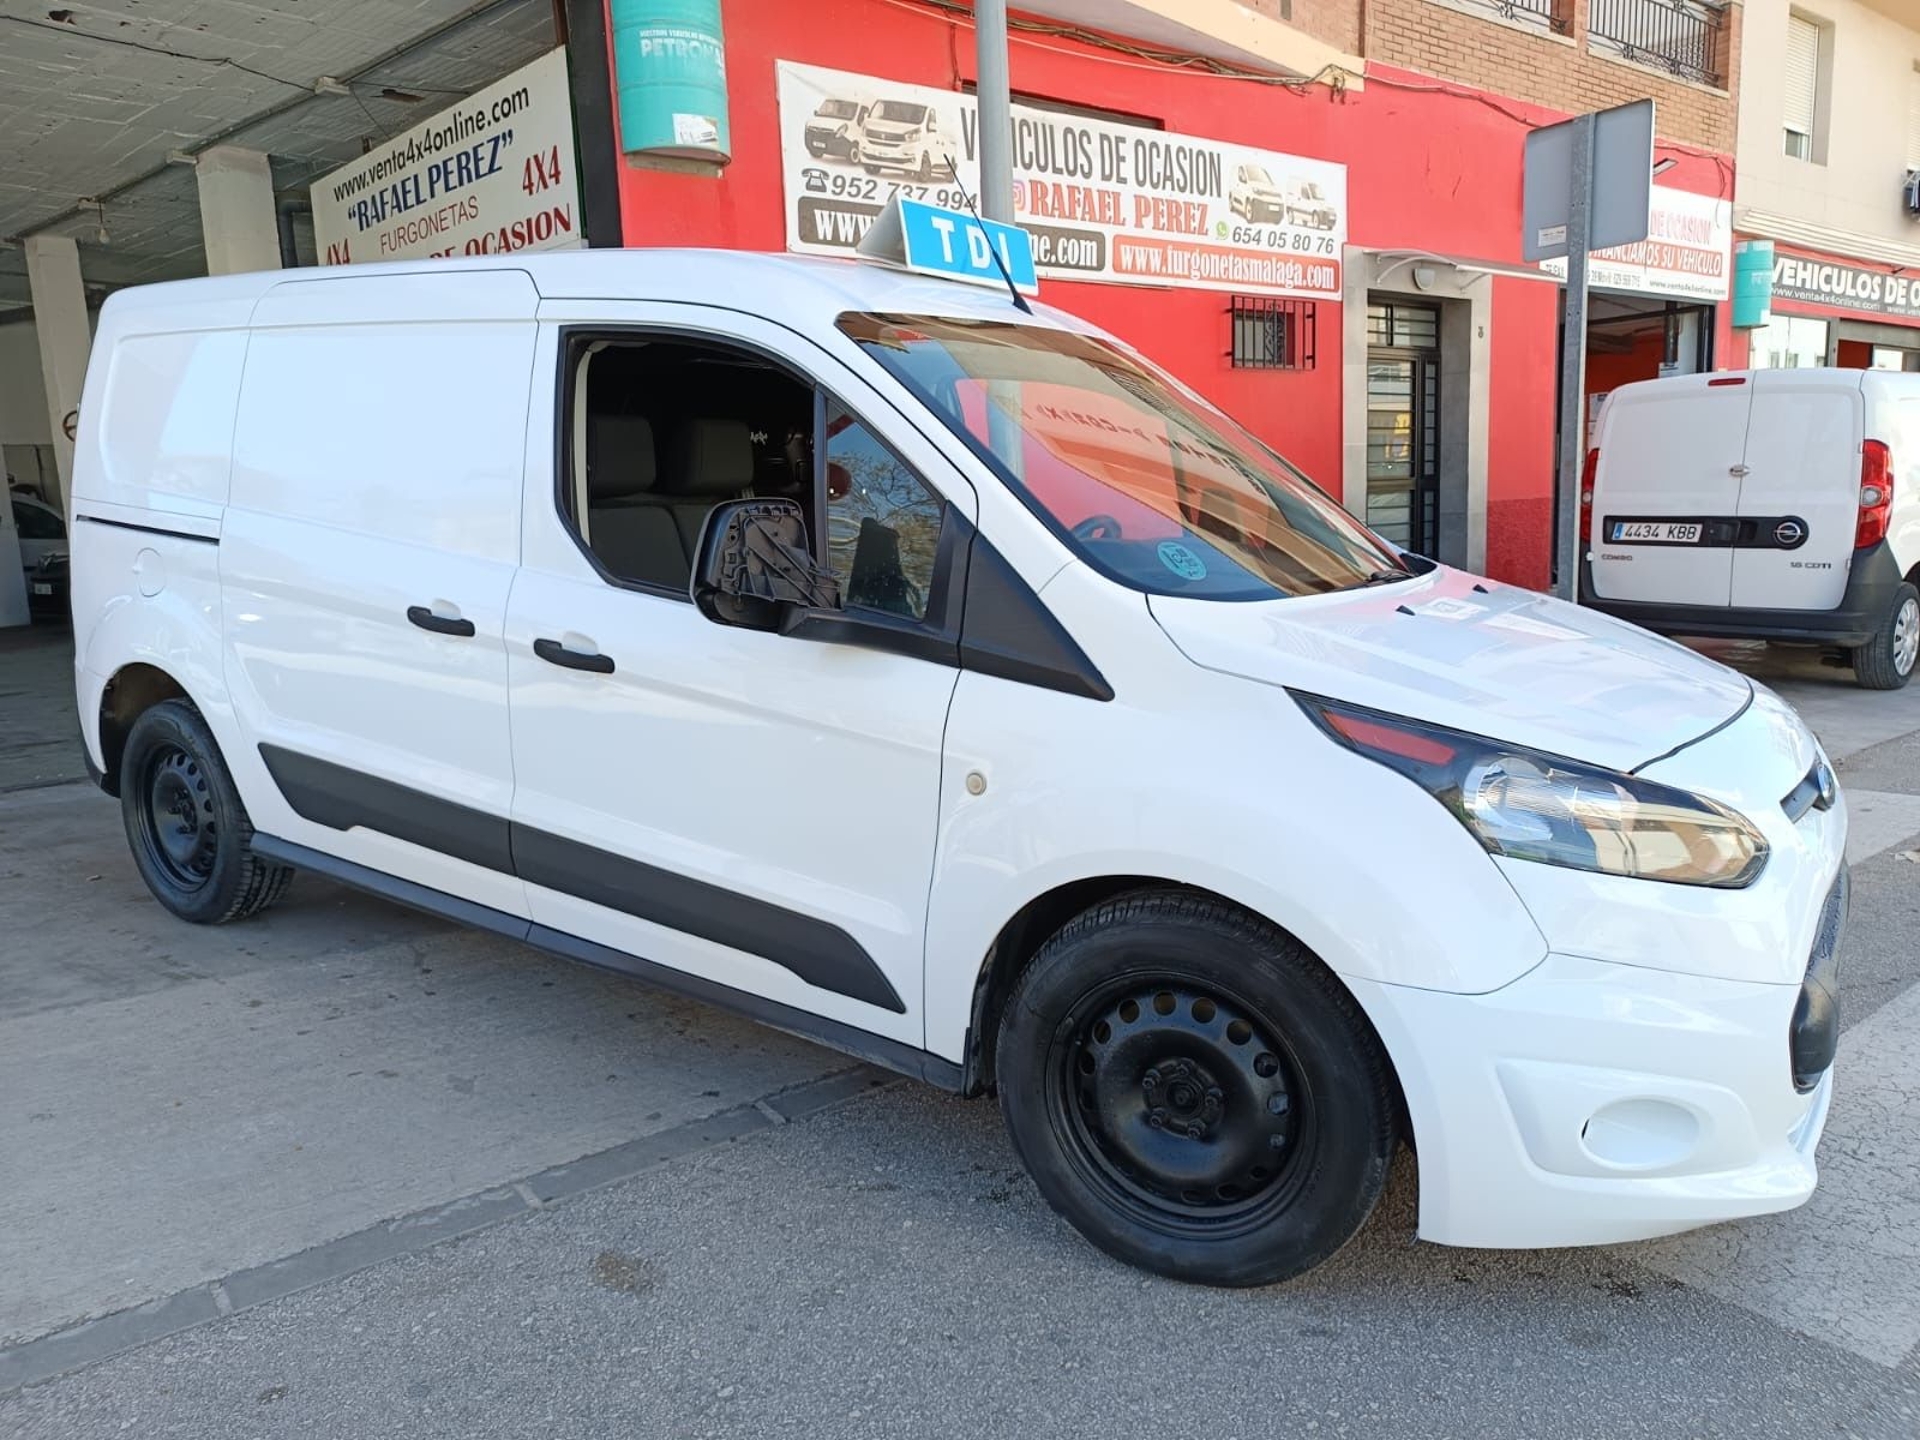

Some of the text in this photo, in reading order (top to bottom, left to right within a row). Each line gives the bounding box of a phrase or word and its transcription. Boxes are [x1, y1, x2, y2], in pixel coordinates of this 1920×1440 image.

[333, 87, 530, 202] www.venta4x4online.com
[960, 107, 1222, 199] VICULOS DE OCASION
[522, 144, 561, 197] 4X4
[832, 174, 878, 200] 952
[936, 189, 978, 212] 994
[380, 195, 479, 255] FURGONETAS
[465, 203, 572, 258] OCASION
[1029, 179, 1209, 236] RAFAEL PEREZ
[1232, 226, 1335, 255] 654 05 80 76
[1588, 242, 1660, 267] ANCIAMOS
[1678, 248, 1722, 275] VEHICULO
[1120, 244, 1335, 289] www.furgonetasmalaga.com
[1883, 275, 1908, 306] DE
[1624, 524, 1697, 540] 4434 KBB
